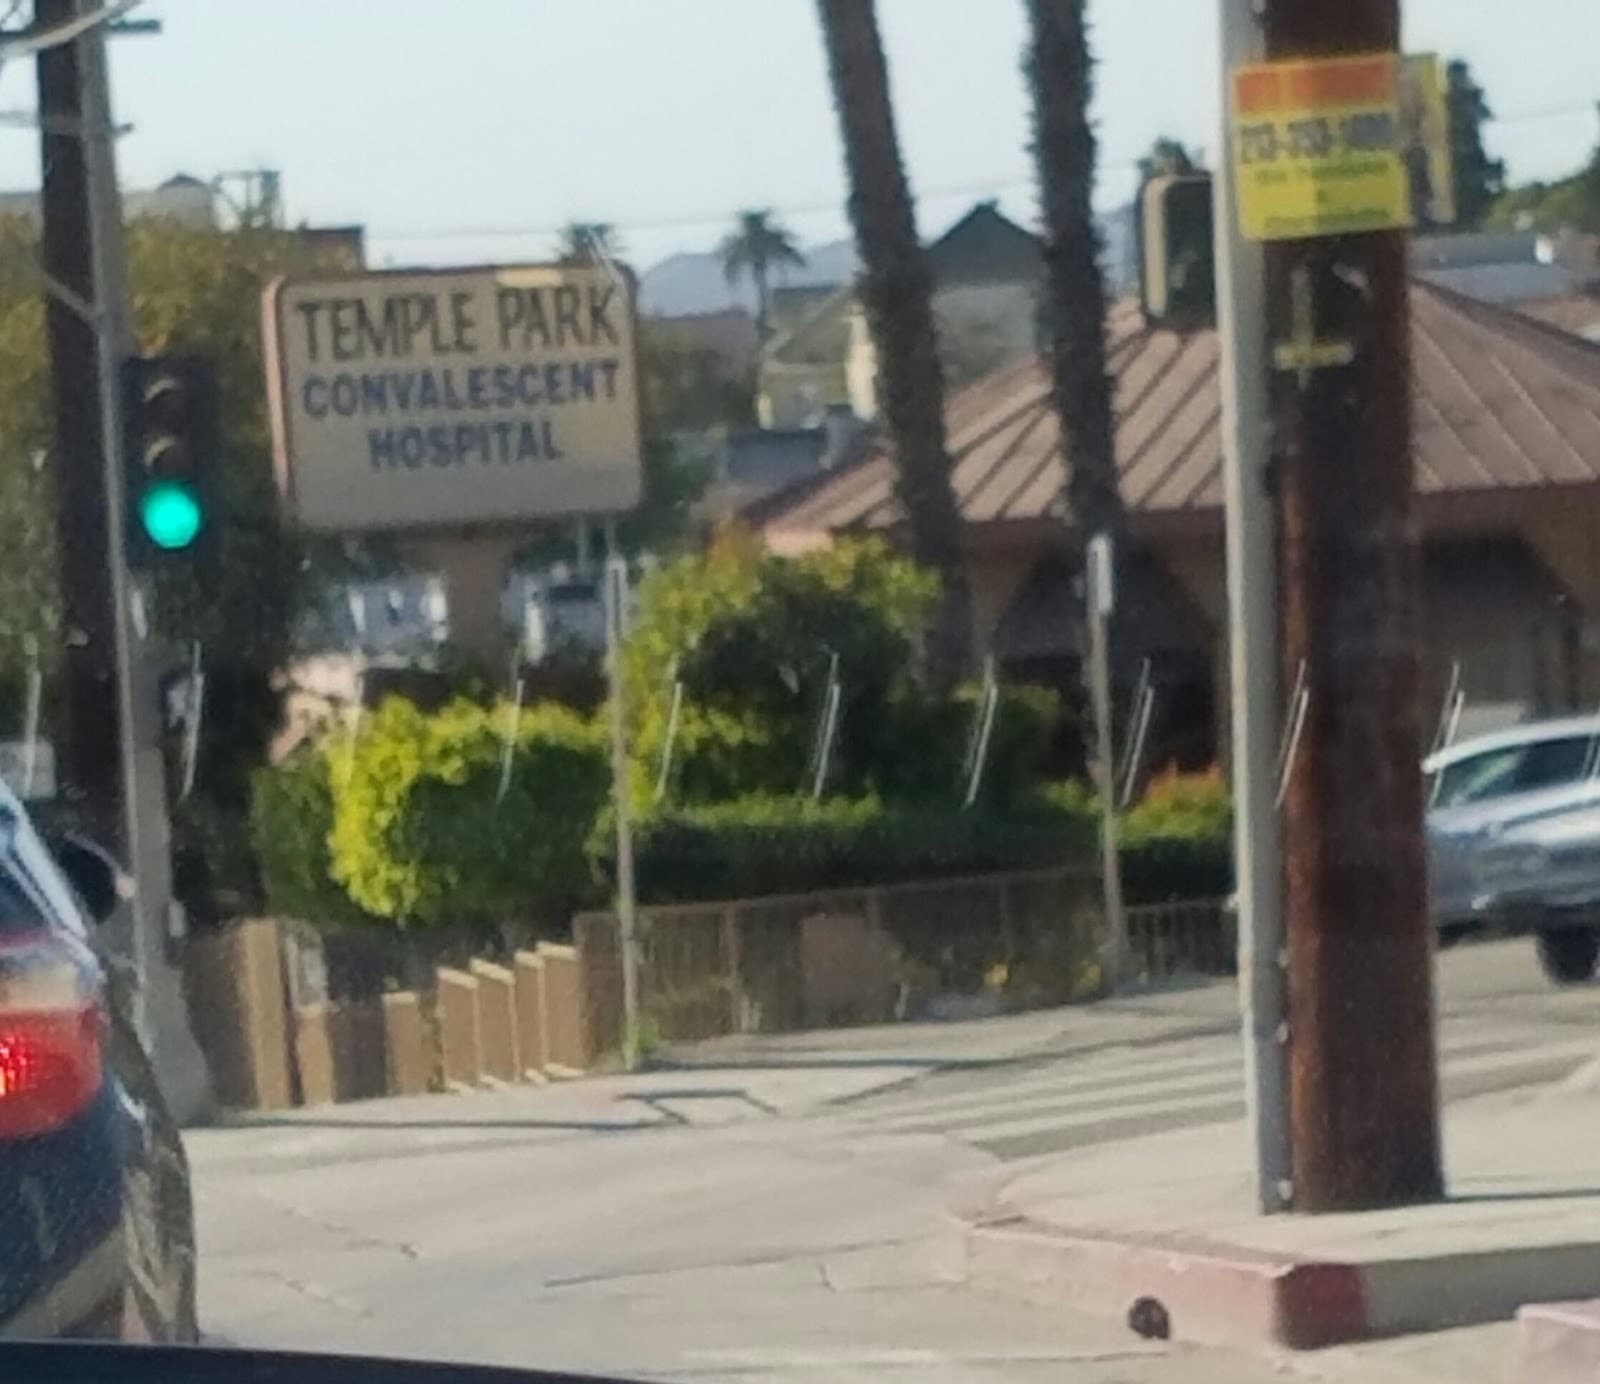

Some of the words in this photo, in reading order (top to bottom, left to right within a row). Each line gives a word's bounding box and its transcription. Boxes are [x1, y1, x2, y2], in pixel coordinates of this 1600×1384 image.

[297, 292, 478, 361] TEMPLE
[498, 283, 619, 351] PARK
[303, 358, 618, 418] CONVALESCENT
[368, 421, 563, 470] HOSPITAL
